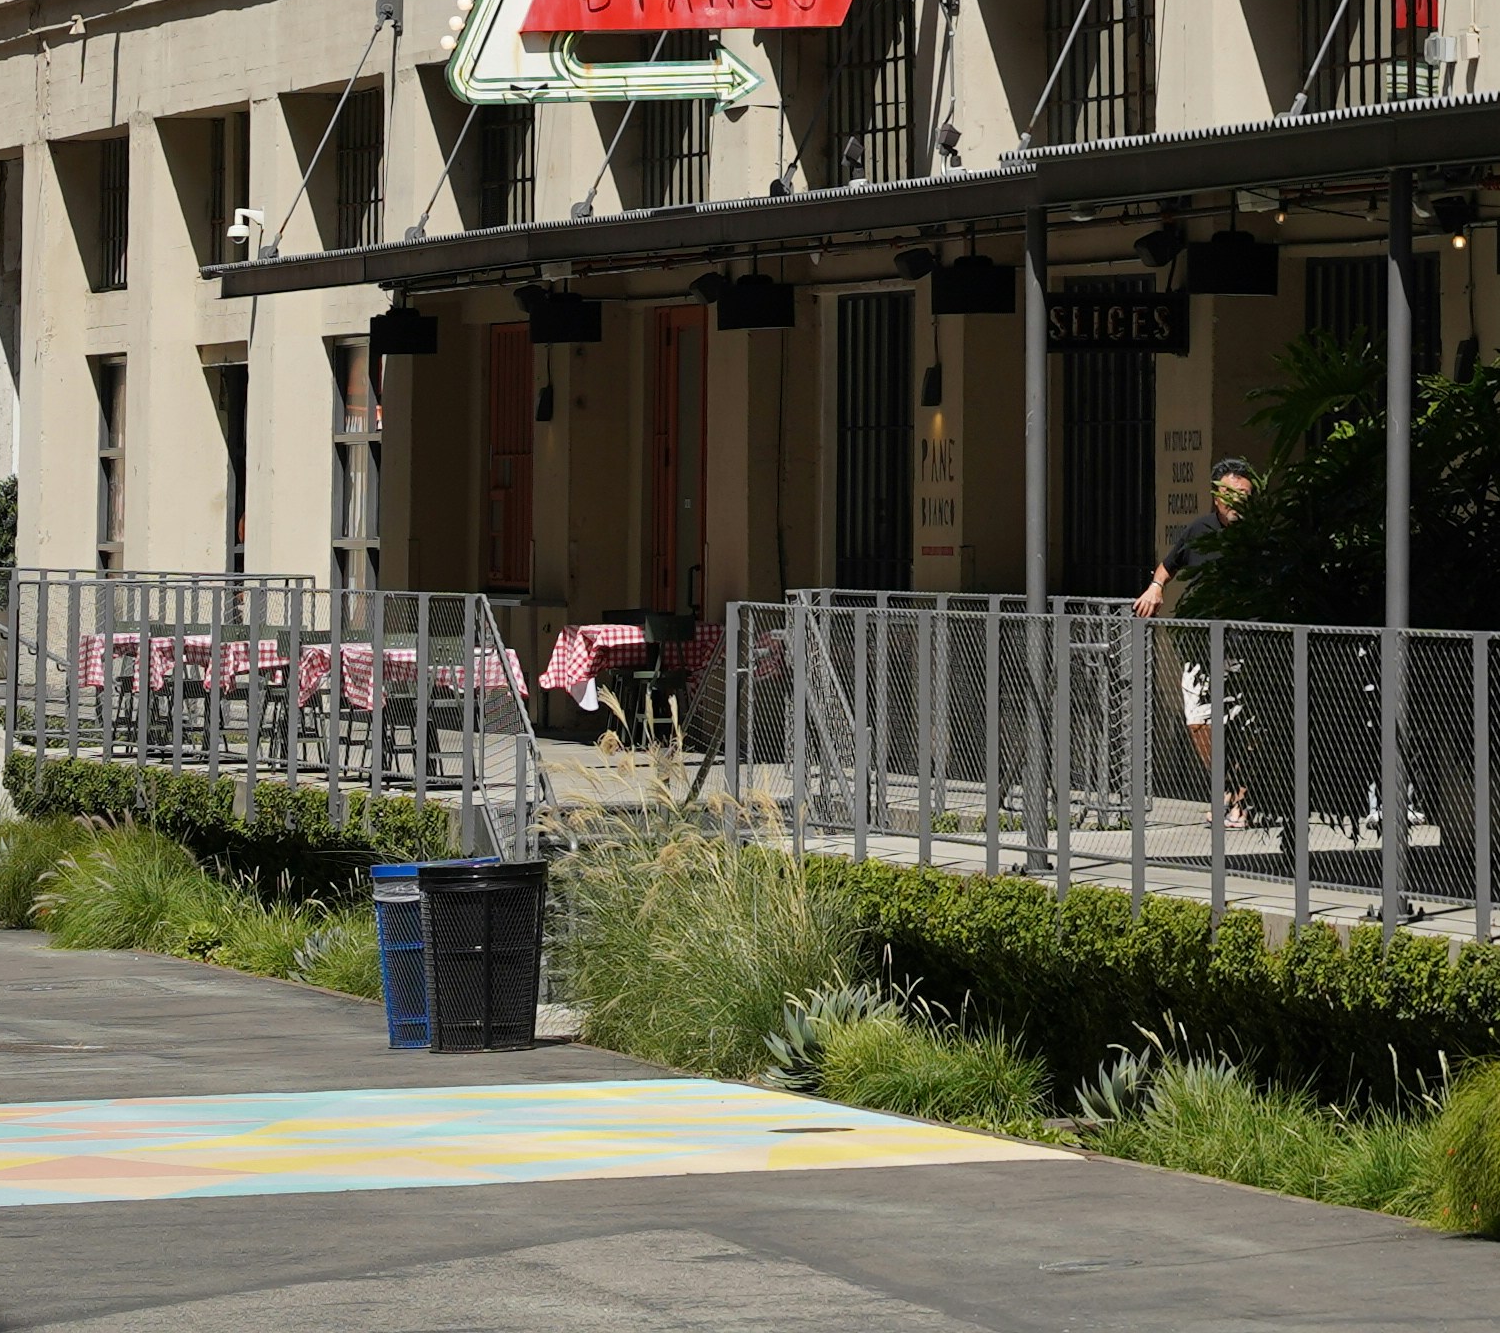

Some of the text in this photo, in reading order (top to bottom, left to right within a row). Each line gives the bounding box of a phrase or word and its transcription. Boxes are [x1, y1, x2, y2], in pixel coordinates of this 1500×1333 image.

[1050, 306, 1171, 341] SLICES
[921, 438, 955, 483] PANE
[1172, 461, 1194, 484] SLICES
[921, 496, 956, 527] BIANCO
[1167, 493, 1199, 515] FOCACCIA
